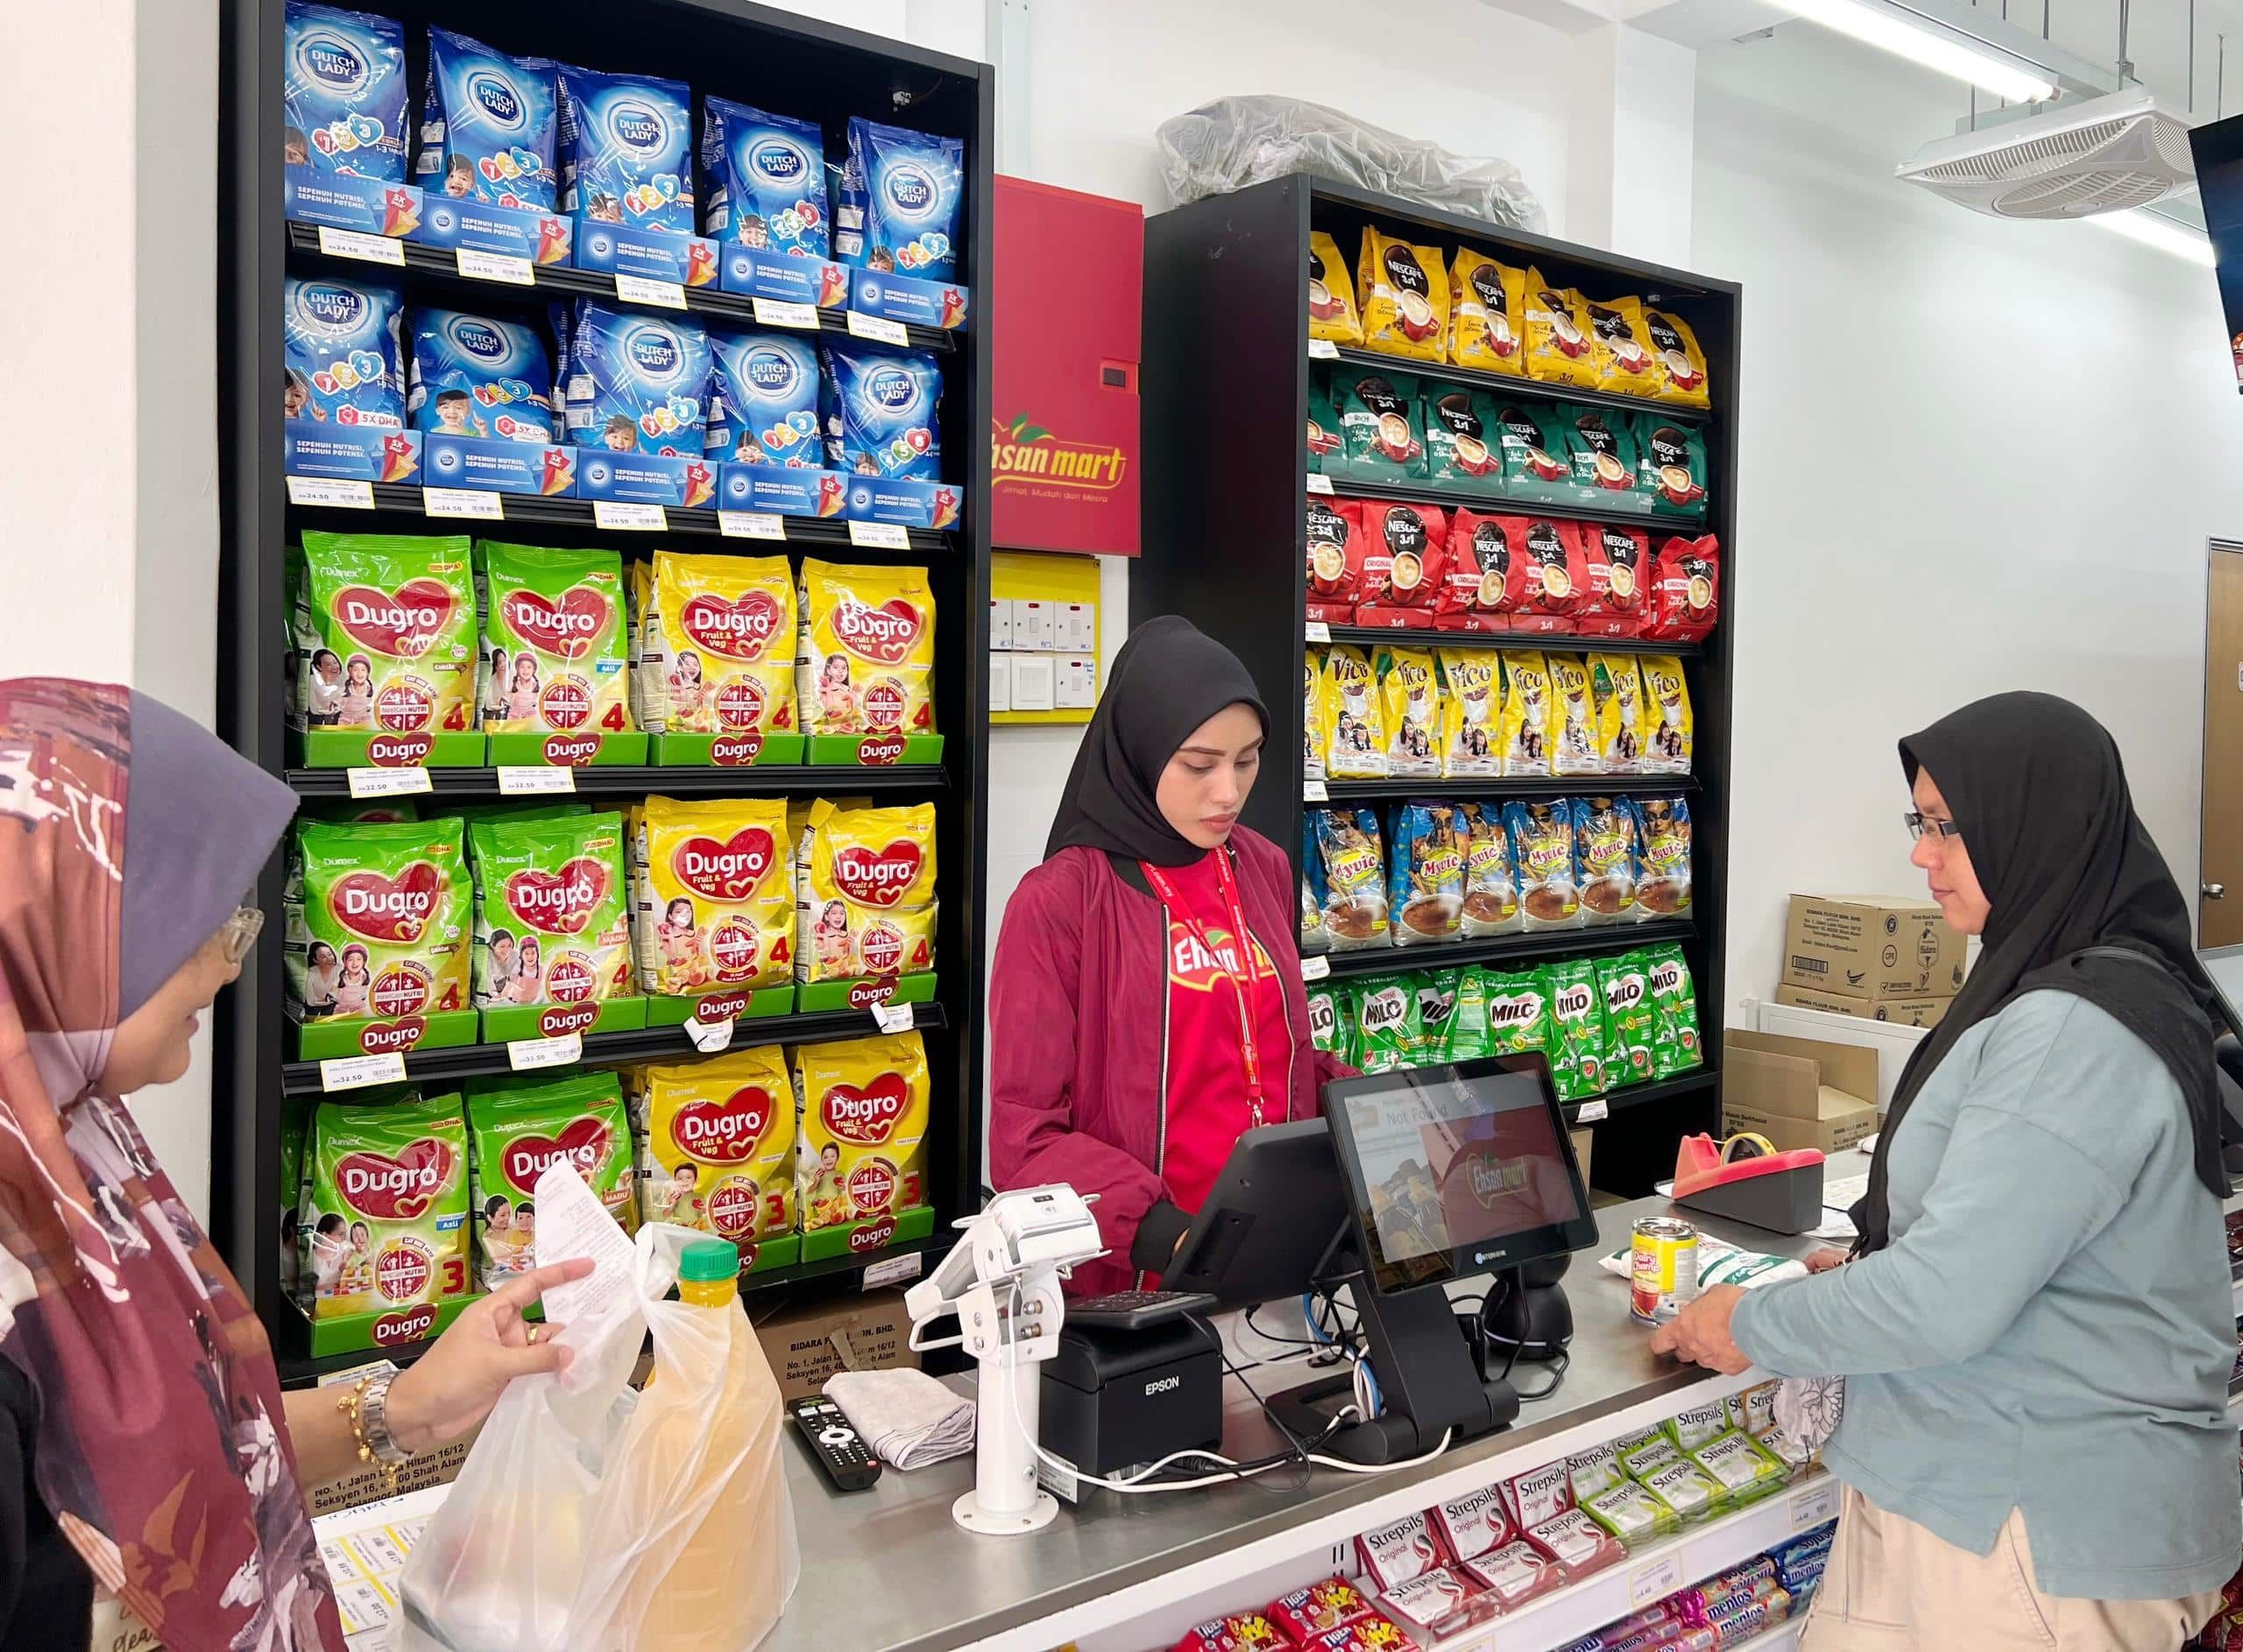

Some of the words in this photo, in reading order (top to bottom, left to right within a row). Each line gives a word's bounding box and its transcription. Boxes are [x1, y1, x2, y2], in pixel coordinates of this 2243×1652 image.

[312, 50, 355, 71] DUTCH
[316, 60, 352, 76] LADY
[480, 86, 515, 109] DUTCH
[484, 96, 513, 114] LADY
[619, 118, 655, 136] DUTCH
[625, 128, 652, 141] LADY
[761, 154, 797, 168] DUTCH
[767, 161, 795, 172] LADY
[298, 186, 332, 198] SEPENUH
[311, 293, 354, 307] DUTCH
[316, 304, 350, 319] LADY
[460, 330, 499, 348] DUTCH
[465, 340, 495, 352] LADY
[637, 342, 673, 357] DUTCH
[641, 354, 669, 367] LADY
[753, 364, 788, 375] DUTCH
[757, 371, 785, 384] LADY
[876, 378, 909, 392] DUTCH
[880, 389, 906, 399] LADY
[296, 440, 331, 450] SEPENUH
[992, 434, 1049, 474] hsan
[1050, 448, 1125, 481] mart
[1082, 494, 1108, 503] Mesra
[347, 602, 439, 633] Dugro
[516, 604, 597, 636] Dugro
[695, 609, 769, 638] Dugro
[838, 613, 912, 640] Dugro
[701, 632, 724, 641] Fruit
[709, 639, 726, 649] Veg
[850, 636, 870, 645] Fruit
[857, 642, 873, 653] Veg
[1333, 657, 1369, 681] Vico
[442, 702, 466, 732] 4
[601, 702, 626, 731] 4
[772, 702, 791, 729] 4
[912, 702, 930, 727] 4
[372, 742, 428, 764] Dugro
[546, 741, 597, 763] Dugro
[714, 742, 759, 759] Dugro
[861, 742, 902, 759] Dugro
[1469, 846, 1499, 867] yvic
[1532, 845, 1565, 865] Myvic
[1591, 839, 1624, 861] Myvic
[685, 851, 764, 879] Dugro
[843, 861, 912, 886] Dugro
[1334, 854, 1376, 879] Myvic
[1423, 855, 1459, 878] Myvic
[692, 875, 713, 884] Fruit
[700, 881, 716, 892] Veg
[846, 881, 867, 890] Fruit
[517, 884, 595, 916] Dugro
[853, 887, 868, 897] Veg
[345, 888, 430, 919] Dugro
[769, 936, 789, 964] 4
[911, 939, 929, 964] 4
[612, 963, 628, 985] 4
[1650, 970, 1679, 991] MILO
[439, 983, 459, 1012] 4
[852, 984, 893, 1002] Dugro
[1607, 984, 1640, 1007] MILO
[699, 999, 746, 1018] Dugro
[1491, 1000, 1535, 1023] MILO
[1555, 993, 1588, 1016] MILO
[542, 1009, 593, 1031] Dugro
[1311, 1006, 1334, 1032] LO
[364, 1026, 421, 1048] Dugro
[831, 1094, 898, 1120] Dugro
[684, 1110, 761, 1140] Dugro
[836, 1119, 853, 1128] Fruit
[843, 1126, 858, 1135] Veg
[693, 1139, 713, 1149] Fruit
[701, 1145, 718, 1155] Veg
[345, 1165, 439, 1197] Dugro
[902, 1176, 920, 1205] 3
[1474, 1165, 1504, 1194] Ehsan
[767, 1195, 786, 1225] 3
[442, 1218, 459, 1229] Asli
[851, 1224, 893, 1246] Dugro
[1632, 1262, 1661, 1275] Champ
[1633, 1252, 1658, 1267] Dairy
[442, 1260, 465, 1295] 3
[376, 1315, 432, 1339] Dugro
[790, 1338, 823, 1352] BIDARA
[875, 1324, 895, 1334] BHD.
[786, 1368, 819, 1380] Seksyen
[877, 1352, 896, 1362] Alam
[787, 1361, 801, 1370] No.
[811, 1354, 832, 1366] Jalan
[876, 1340, 896, 1353] 16/12
[1145, 1375, 1180, 1396] EPSON
[1750, 1389, 1776, 1409] Strep
[1678, 1406, 1724, 1426] Strepsils
[1567, 1444, 1615, 1473] Strepsils
[1630, 1441, 1674, 1470] Strepsils
[1701, 1433, 1746, 1464] Strepsils
[336, 1480, 345, 1491] 1,
[348, 1472, 377, 1487] Jalan
[407, 1452, 436, 1470] Hitam
[438, 1443, 464, 1458] 16/12
[1652, 1459, 1695, 1490] Strepsils
[315, 1488, 361, 1509] Seksyen
[363, 1482, 379, 1495] 16,
[413, 1464, 439, 1479] Shah
[441, 1455, 466, 1470] Alam
[396, 1475, 443, 1496] Malaysia.
[1520, 1466, 1567, 1497] Strepsils
[1447, 1486, 1497, 1521] Strepsils
[1524, 1494, 1549, 1512] Original
[1596, 1478, 1644, 1512] Strepsils
[1369, 1512, 1425, 1550] Strepsils
[1454, 1516, 1482, 1535] Original
[1537, 1509, 1587, 1541] Strepsils
[1378, 1545, 1409, 1564] Original
[1475, 1542, 1528, 1567] Strepsils
[1790, 1562, 1825, 1582] mentos
[1390, 1571, 1447, 1600] Strepsils
[1280, 1588, 1312, 1606] TIGER
[1708, 1590, 1752, 1621] mentos
[1193, 1618, 1225, 1638] TIGER
[1320, 1626, 1352, 1647] TIGER
